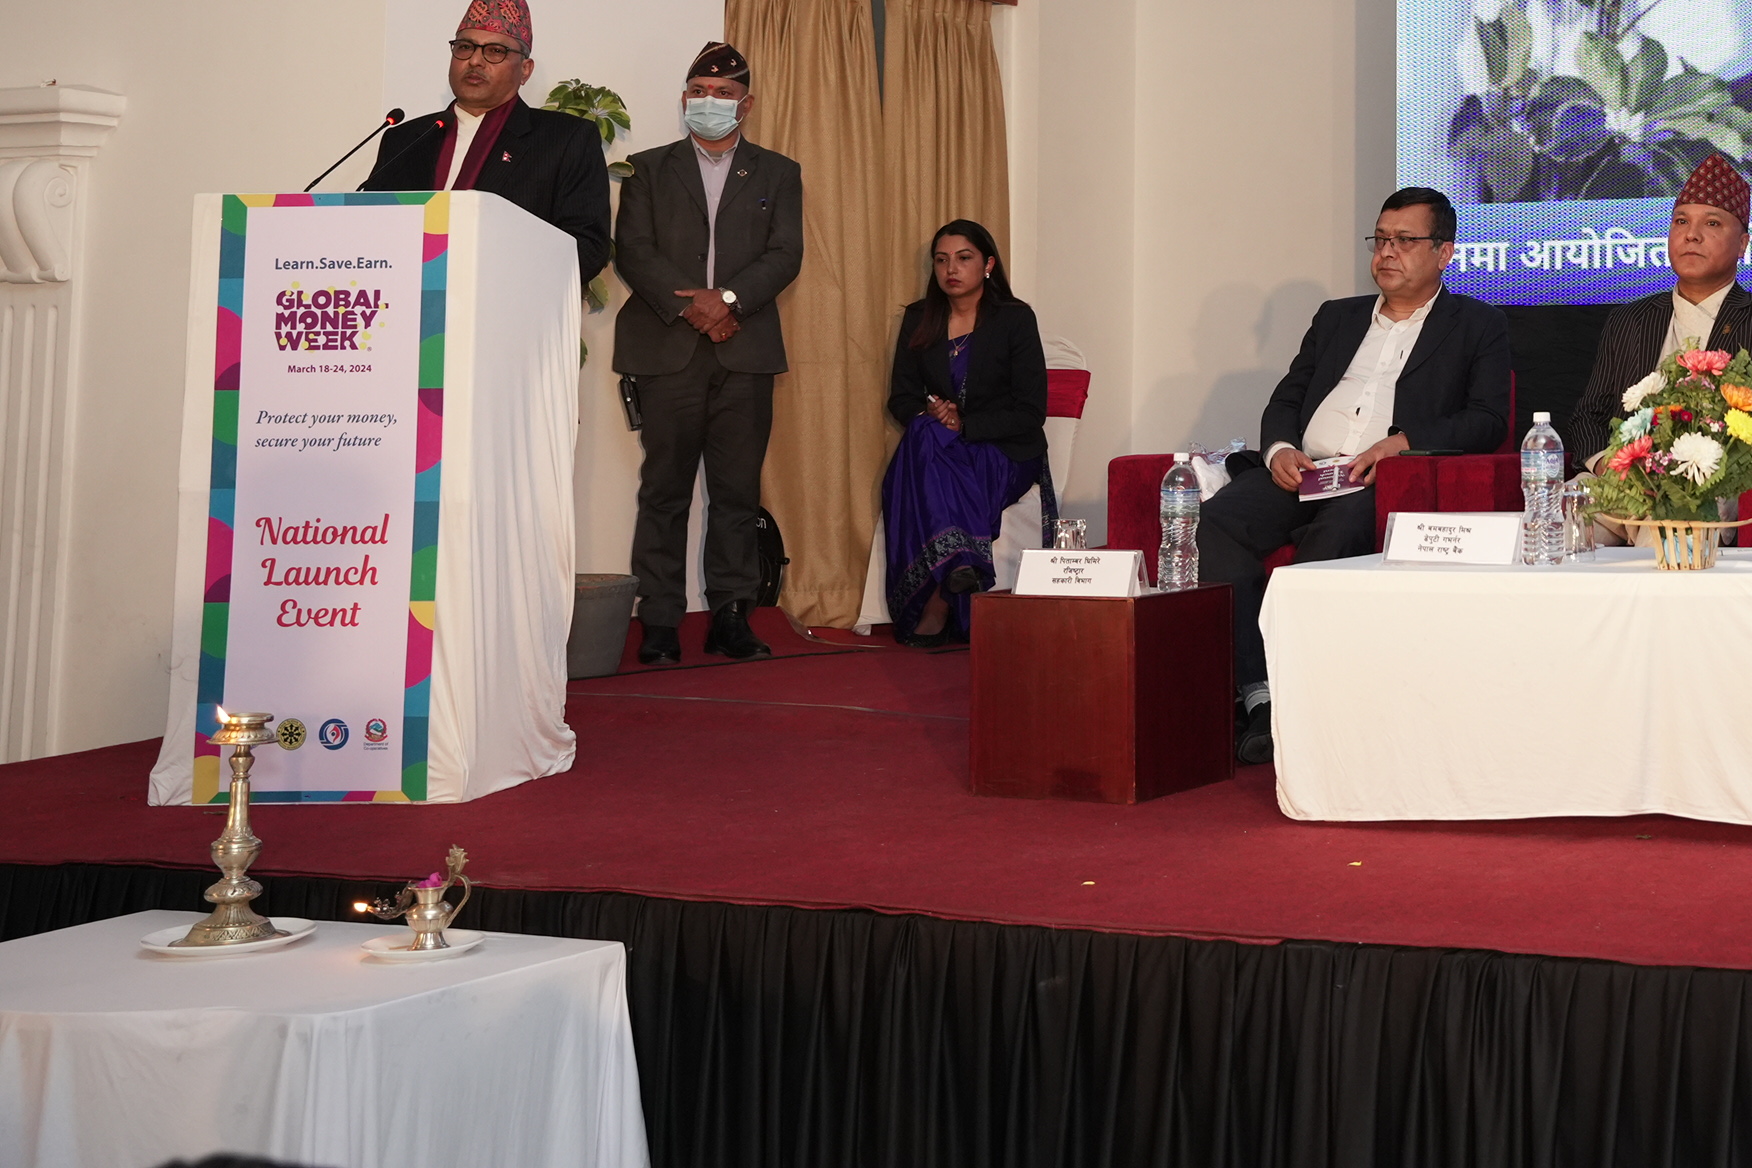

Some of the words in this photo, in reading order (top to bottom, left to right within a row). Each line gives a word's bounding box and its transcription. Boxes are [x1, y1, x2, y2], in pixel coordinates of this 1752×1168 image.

[1521, 227, 1671, 270] आयोजित
[275, 257, 392, 270] Learn.Save.Earn.
[276, 289, 389, 310] GLOBAL
[275, 310, 378, 330] MONEY
[274, 331, 359, 351] WEEK
[288, 365, 315, 373] March
[319, 365, 346, 373] 18-24,
[256, 411, 308, 424] Protect
[308, 414, 344, 428] your
[346, 414, 397, 428] money,
[255, 437, 298, 447] secure
[299, 437, 334, 452] your
[333, 432, 381, 451] future
[255, 513, 389, 545] National
[1424, 534, 1439, 544] डेपुटी
[1418, 544, 1434, 552] नेपाल
[261, 554, 378, 586] Launch
[277, 599, 361, 627] Event
